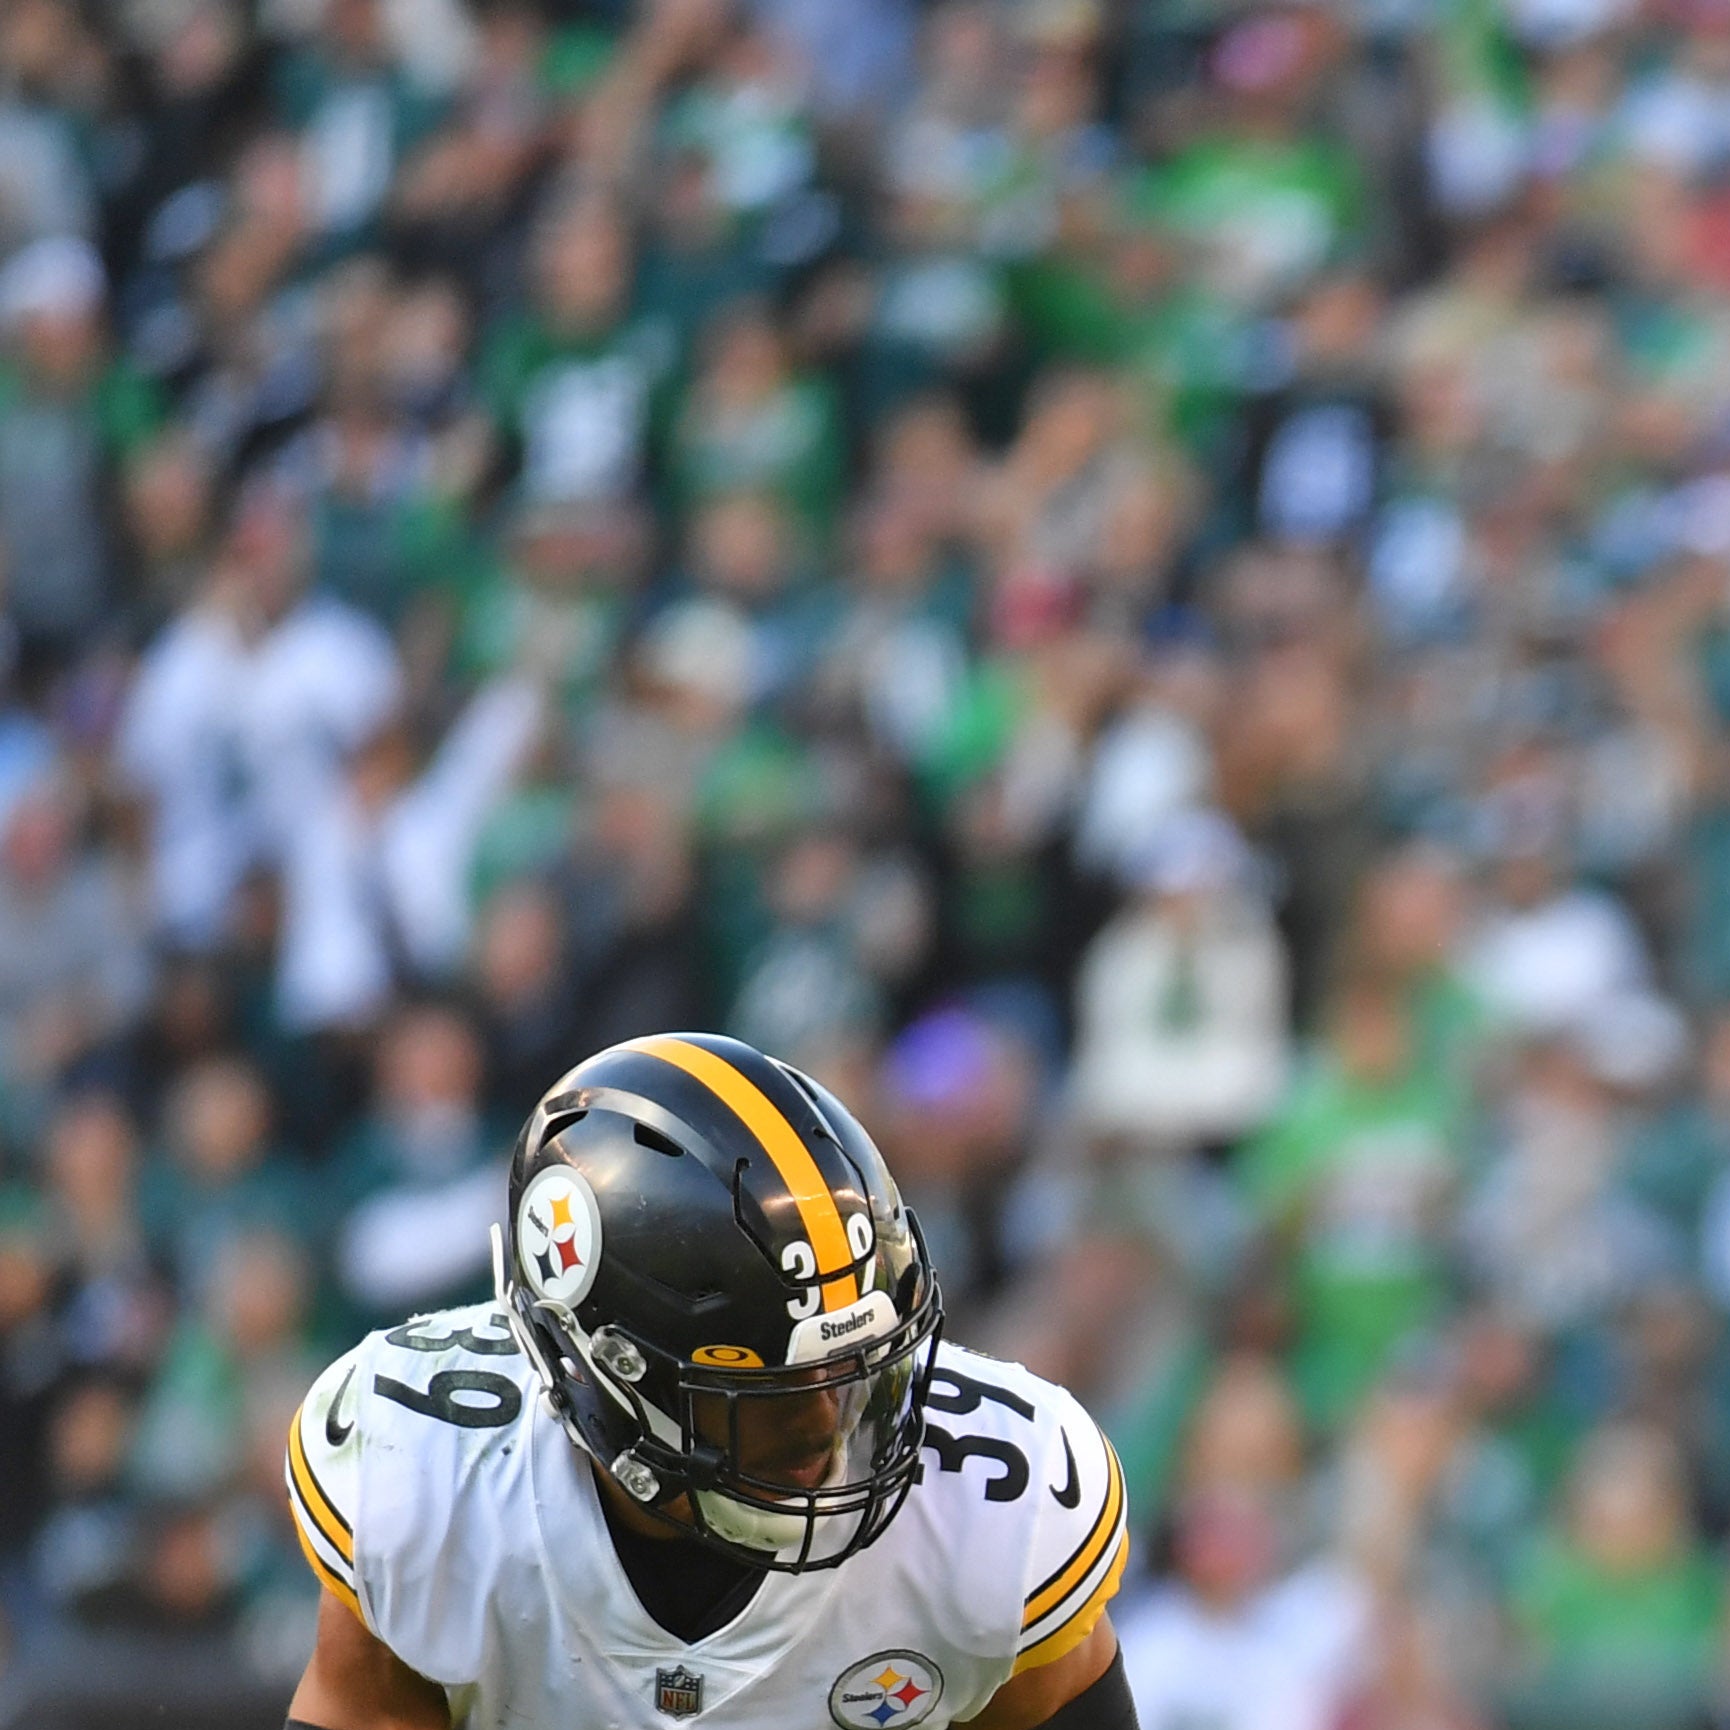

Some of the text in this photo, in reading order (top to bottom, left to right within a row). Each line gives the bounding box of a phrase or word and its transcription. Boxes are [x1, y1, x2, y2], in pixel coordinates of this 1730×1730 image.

[781, 1212, 877, 1321] 39
[373, 1312, 523, 1430] 39
[820, 1308, 876, 1342] Steelers
[911, 1366, 1036, 1503] 39
